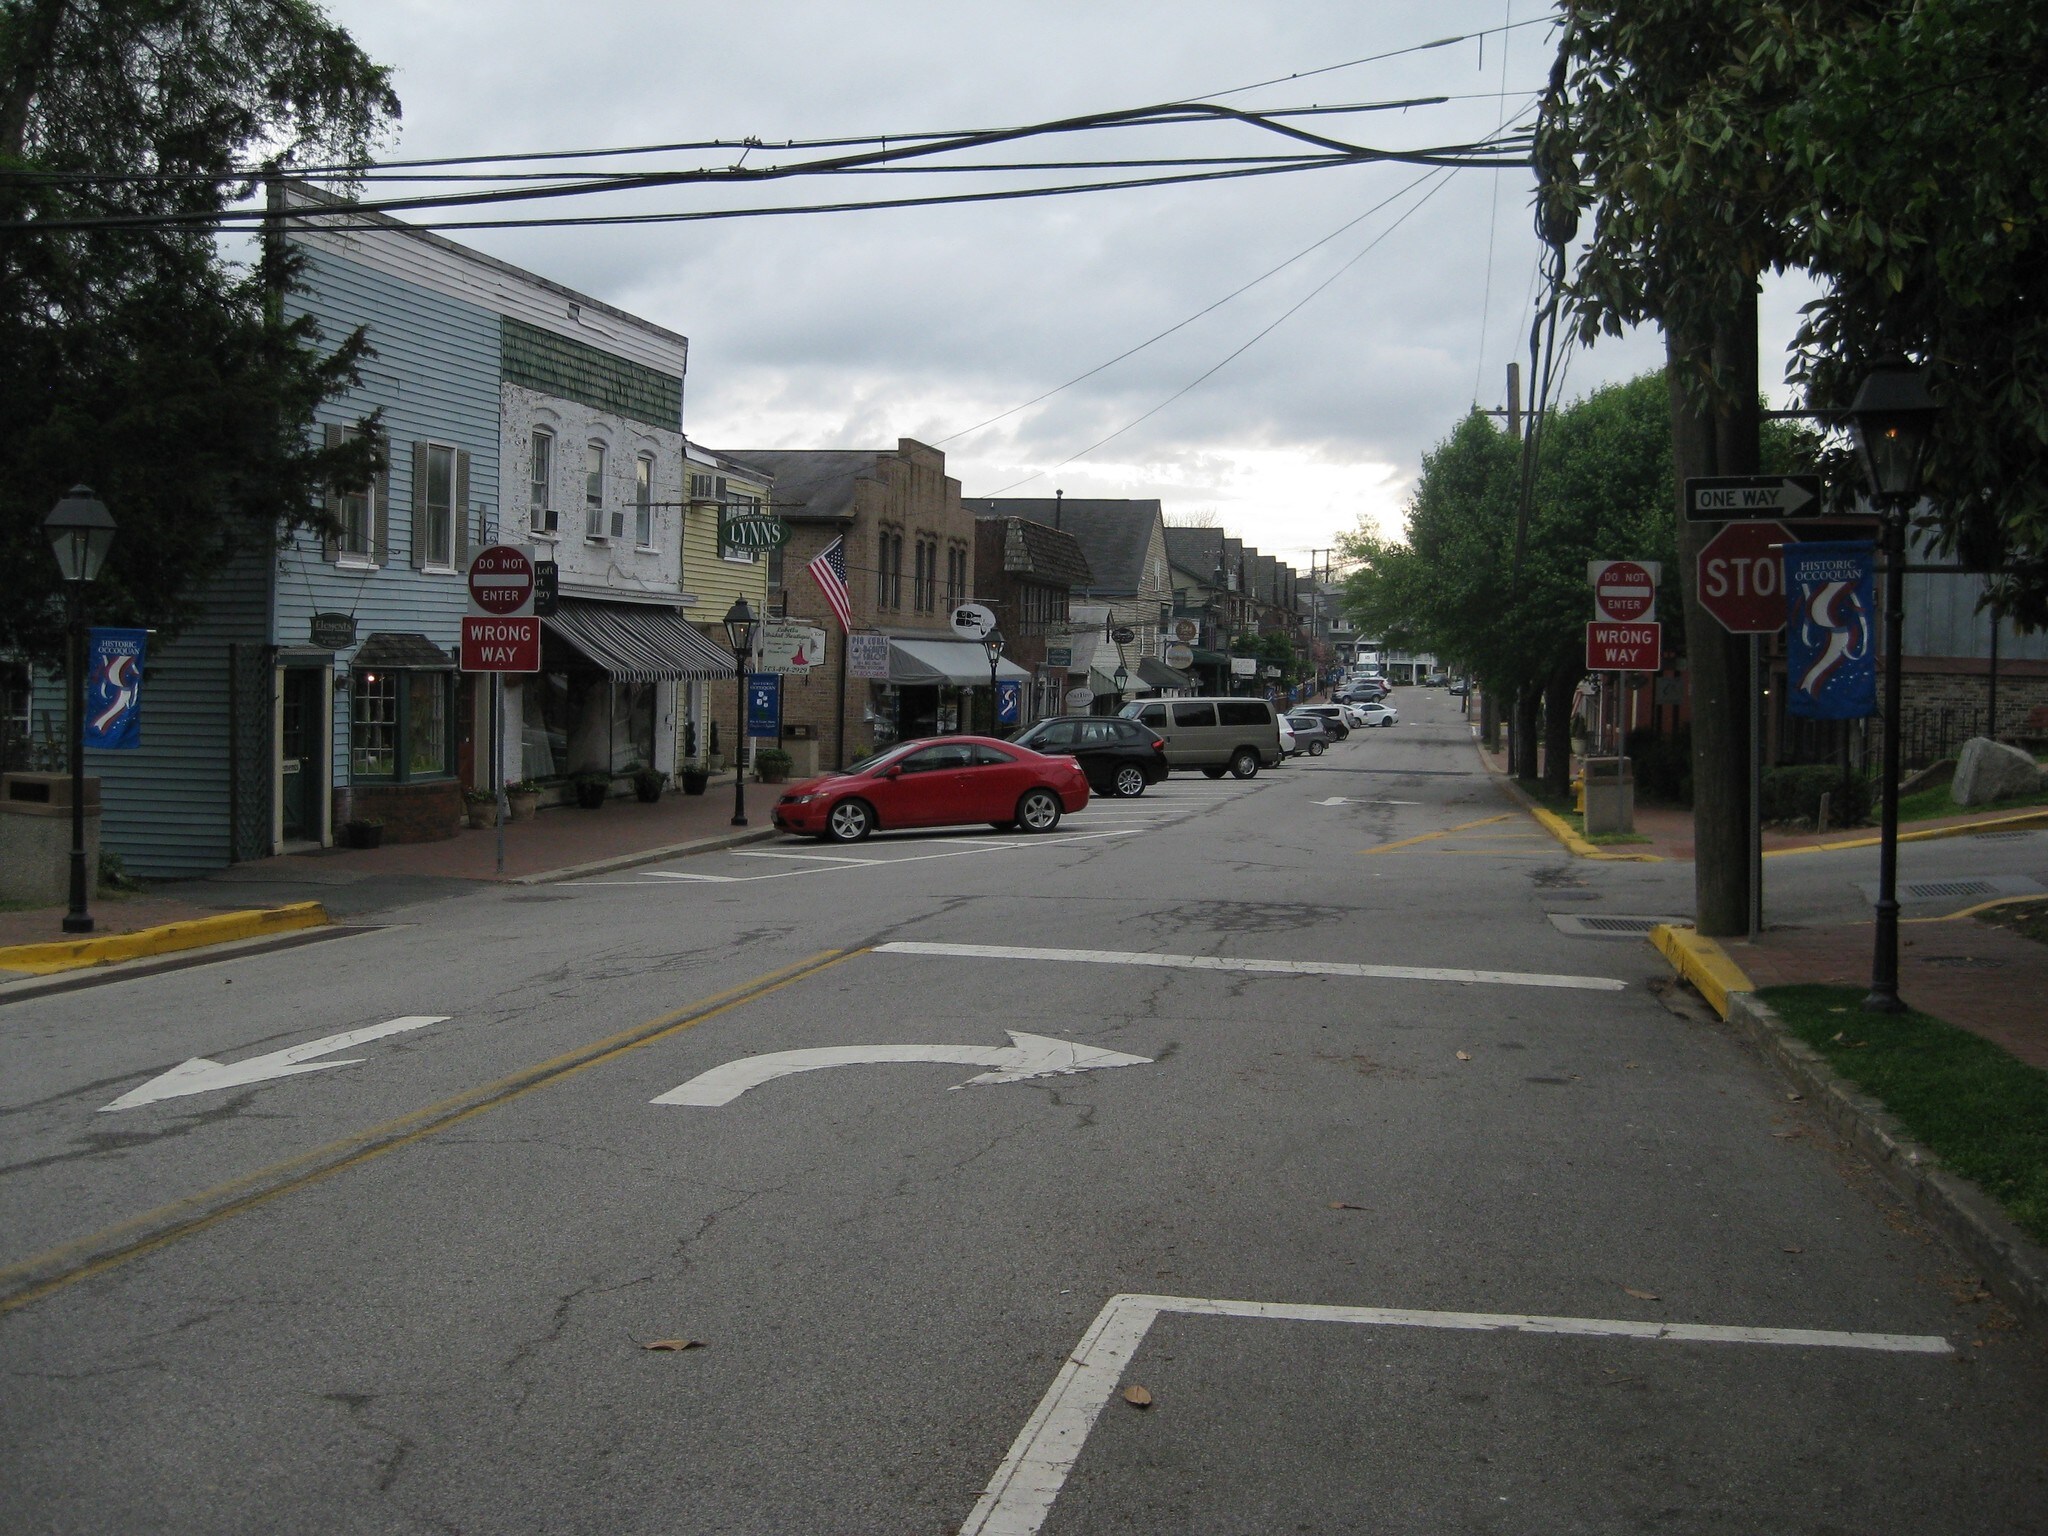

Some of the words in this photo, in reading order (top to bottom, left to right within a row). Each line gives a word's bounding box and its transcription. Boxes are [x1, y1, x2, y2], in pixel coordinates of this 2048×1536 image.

[1700, 491, 1736, 507] ONE
[1742, 489, 1781, 506] WAY
[479, 559, 494, 569] DO
[502, 559, 524, 569] NOT
[1801, 560, 1856, 571] HISTORIC
[538, 567, 553, 575] Loft
[1795, 569, 1862, 581] OCCOQUAN
[1604, 573, 1617, 581] DO
[1625, 573, 1645, 582] NOT
[482, 590, 519, 600] ENTER
[1608, 600, 1640, 609] ENTER
[471, 626, 531, 641] WRONG
[1596, 630, 1652, 644] WRONG
[102, 640, 137, 648] HISTORIC
[98, 646, 140, 655] OCCOQUAN
[481, 647, 517, 662] WAY
[1605, 649, 1639, 662] WAY
